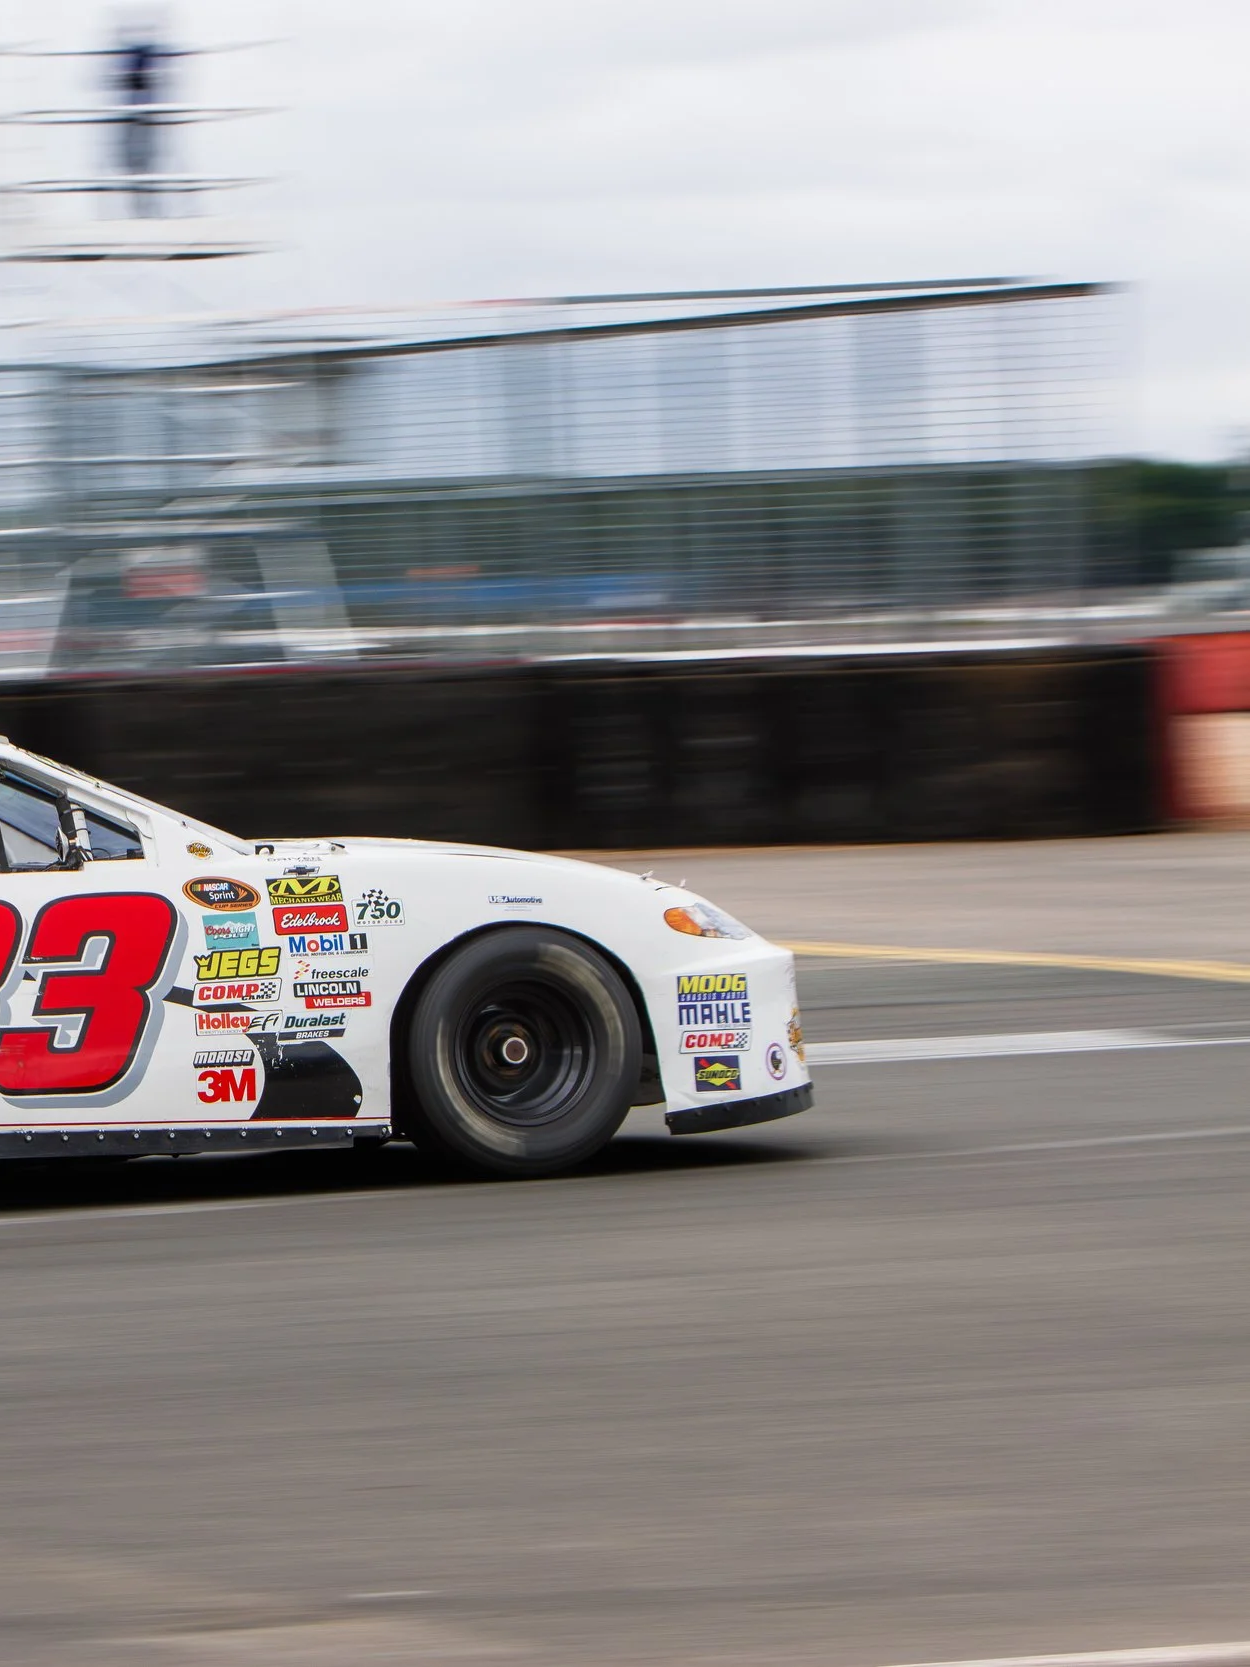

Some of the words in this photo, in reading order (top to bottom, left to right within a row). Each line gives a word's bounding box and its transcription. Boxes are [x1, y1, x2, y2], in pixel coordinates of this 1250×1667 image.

[203, 882, 229, 892] NASCAR
[209, 891, 236, 900] Sprint
[270, 895, 315, 905] MECHANIX
[316, 892, 343, 902] WEAR
[506, 896, 543, 904] Automotive
[356, 901, 401, 921] 750
[280, 912, 341, 929] Edelbrock
[205, 925, 231, 936] Coors
[230, 922, 255, 934] LIGHT
[213, 931, 249, 940] POLE
[288, 933, 344, 954] Mobil
[197, 947, 281, 980] JEGS
[311, 966, 369, 980] freescale
[296, 982, 358, 997] LINCOLN
[678, 974, 746, 994] MOOG
[198, 983, 260, 1001] COMP
[680, 992, 717, 1002] CHASSIS
[721, 991, 745, 1000] PARTS
[313, 996, 366, 1007] WELDERS
[284, 1013, 346, 1029] Duralast
[678, 1002, 751, 1026] MAHLE
[198, 1013, 250, 1032] Holley
[249, 1013, 279, 1031] EFI
[295, 1030, 330, 1040] BRAKES
[685, 1032, 735, 1049] COMP
[194, 1050, 253, 1065] MOROSO
[698, 1069, 738, 1080] SUNOCO
[197, 1068, 256, 1104] 3M
